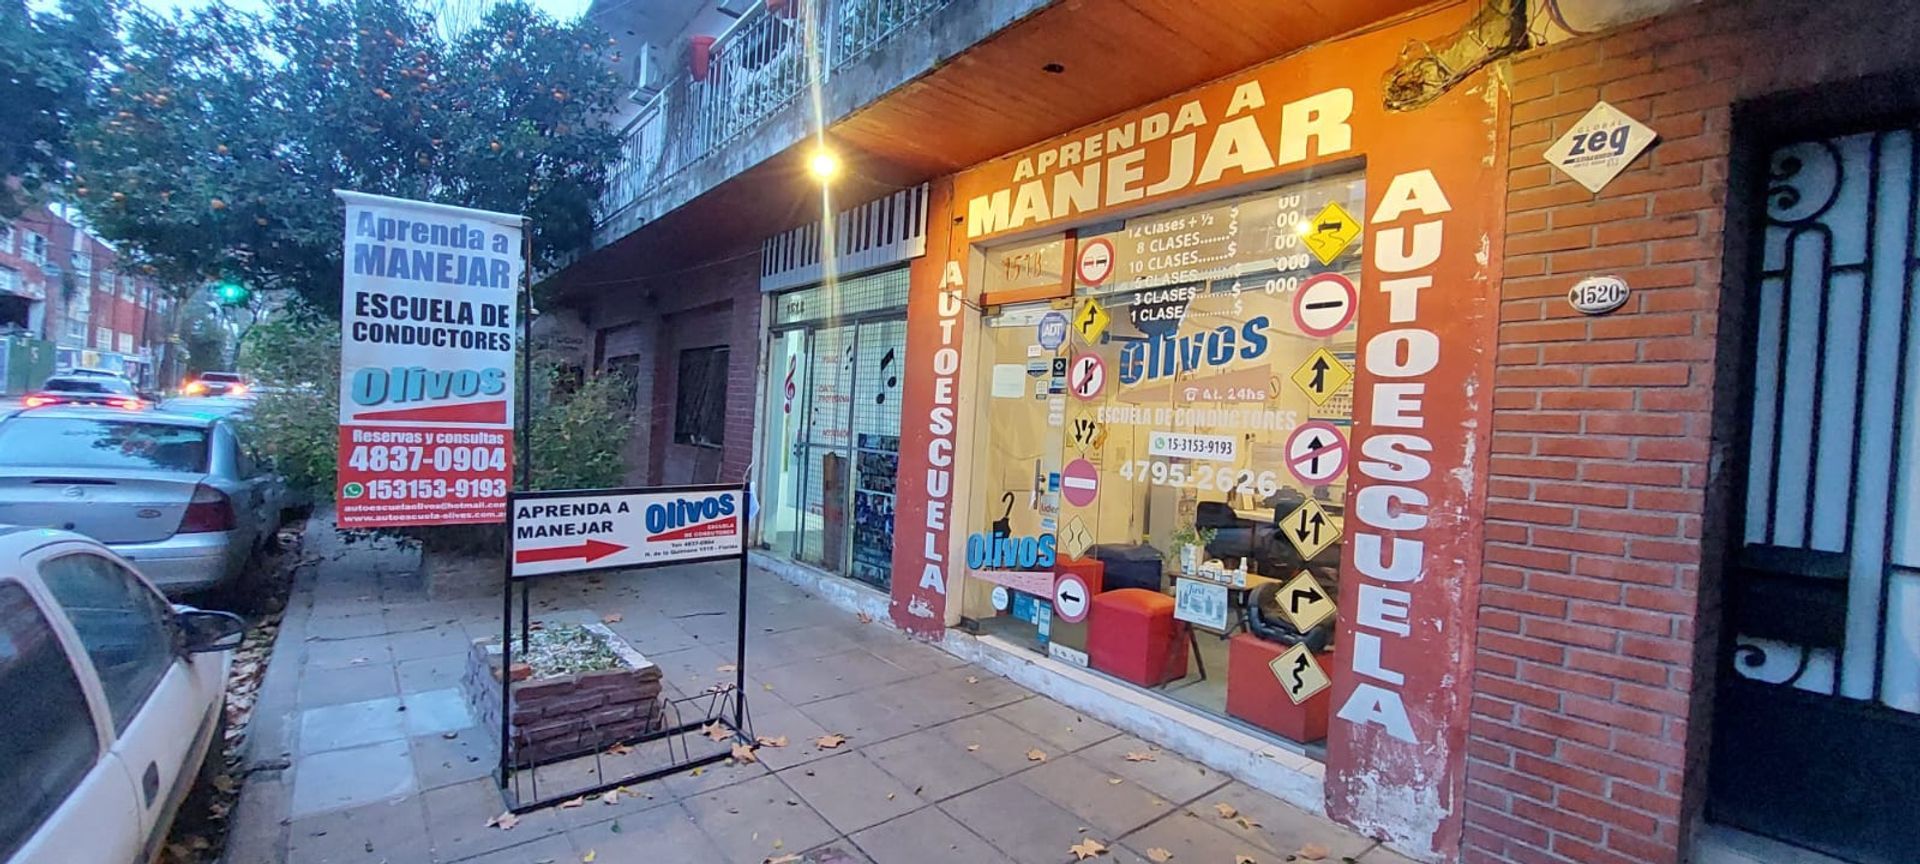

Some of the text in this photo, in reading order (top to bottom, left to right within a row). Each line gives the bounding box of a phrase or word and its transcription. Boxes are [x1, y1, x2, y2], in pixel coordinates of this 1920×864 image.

[1013, 80, 1265, 183] APRENDA A
[967, 87, 1354, 238] MANEJAR
[356, 211, 509, 254] Aprenda a
[1136, 242, 1144, 254] 8
[1277, 211, 1299, 228] 00
[354, 243, 511, 289] MANEJAR
[1129, 260, 1143, 273] 10
[1275, 233, 1297, 250] 00
[1277, 254, 1310, 272] 000
[1133, 293, 1141, 306] 3
[1265, 276, 1297, 295] 000
[1579, 283, 1620, 305] 1520
[355, 291, 510, 328] ESCUELA DE
[1130, 310, 1136, 323] 1
[352, 321, 511, 351] CONDUCTORES
[1043, 322, 1063, 336] ADT
[1118, 316, 1270, 386] Olivos
[351, 366, 506, 406] Olivos
[1227, 388, 1265, 400] 24hs
[920, 260, 964, 595] AUTOESCUELA
[1097, 406, 1297, 431] ESCUELA DE CONDUCTORES
[353, 429, 504, 446] Reservas y consultas
[1167, 437, 1233, 455] 15-3153-9193
[348, 445, 507, 472] 4837-0904
[1336, 169, 1452, 744] AUTOESCUELA
[366, 478, 507, 500] 153153-9193
[1119, 459, 1277, 498] 4795-2626
[516, 501, 630, 519] APRENDA A
[646, 493, 735, 534] Olivos
[517, 521, 614, 539] MANEJAR
[967, 531, 1056, 570] Olivos
